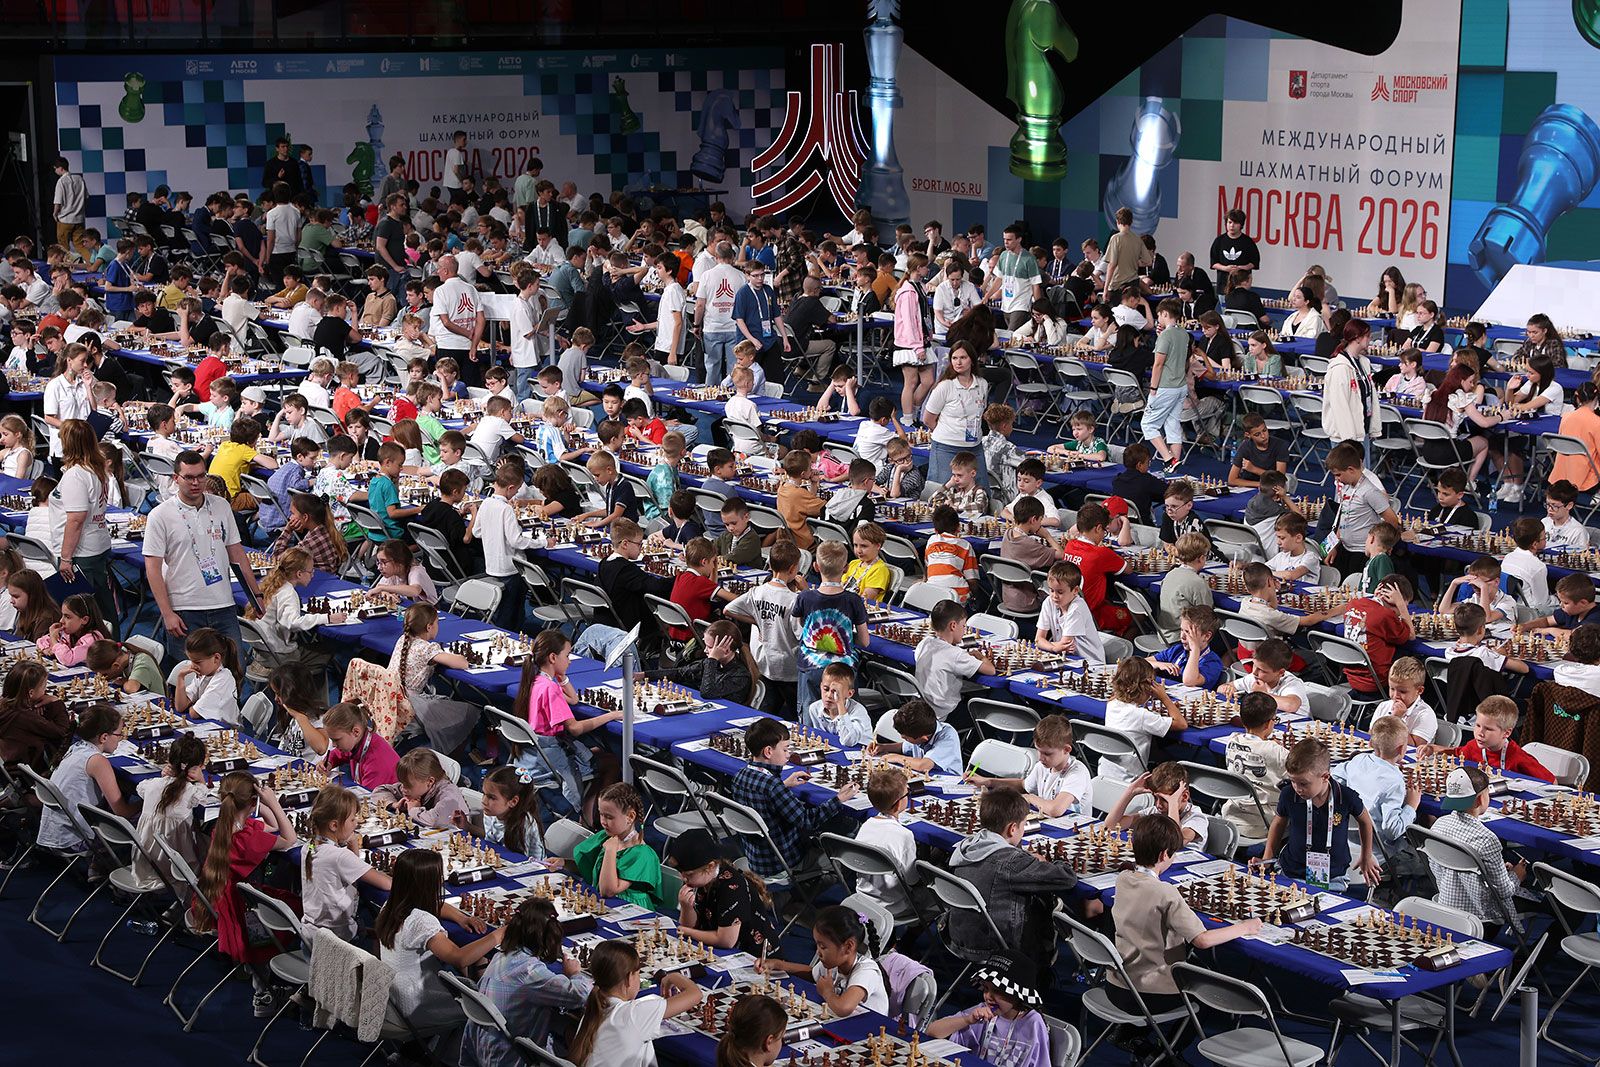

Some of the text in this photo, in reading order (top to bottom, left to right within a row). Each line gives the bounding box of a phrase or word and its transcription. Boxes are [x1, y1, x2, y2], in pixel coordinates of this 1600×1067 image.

[230, 60, 257, 68] ЛЕТО
[1310, 72, 1348, 81] Департамент
[1393, 74, 1448, 90] МОСКОВСКИЙ
[1310, 91, 1329, 99] города
[1393, 90, 1418, 103] СПОРТ
[432, 111, 540, 124] МЕЖДУНАРОДНЫЙ
[419, 129, 540, 142] ШАХМНЫЙ ФОРУМ
[1262, 129, 1446, 155] МЕЖДУНАРОДНЫЙ
[1240, 160, 1444, 189] ШАХМАТНЫЙ ФОРУМ
[912, 178, 982, 196] SPORT.MOS.RU
[1358, 196, 1440, 260] 2026
[761, 610, 776, 621] BAY
